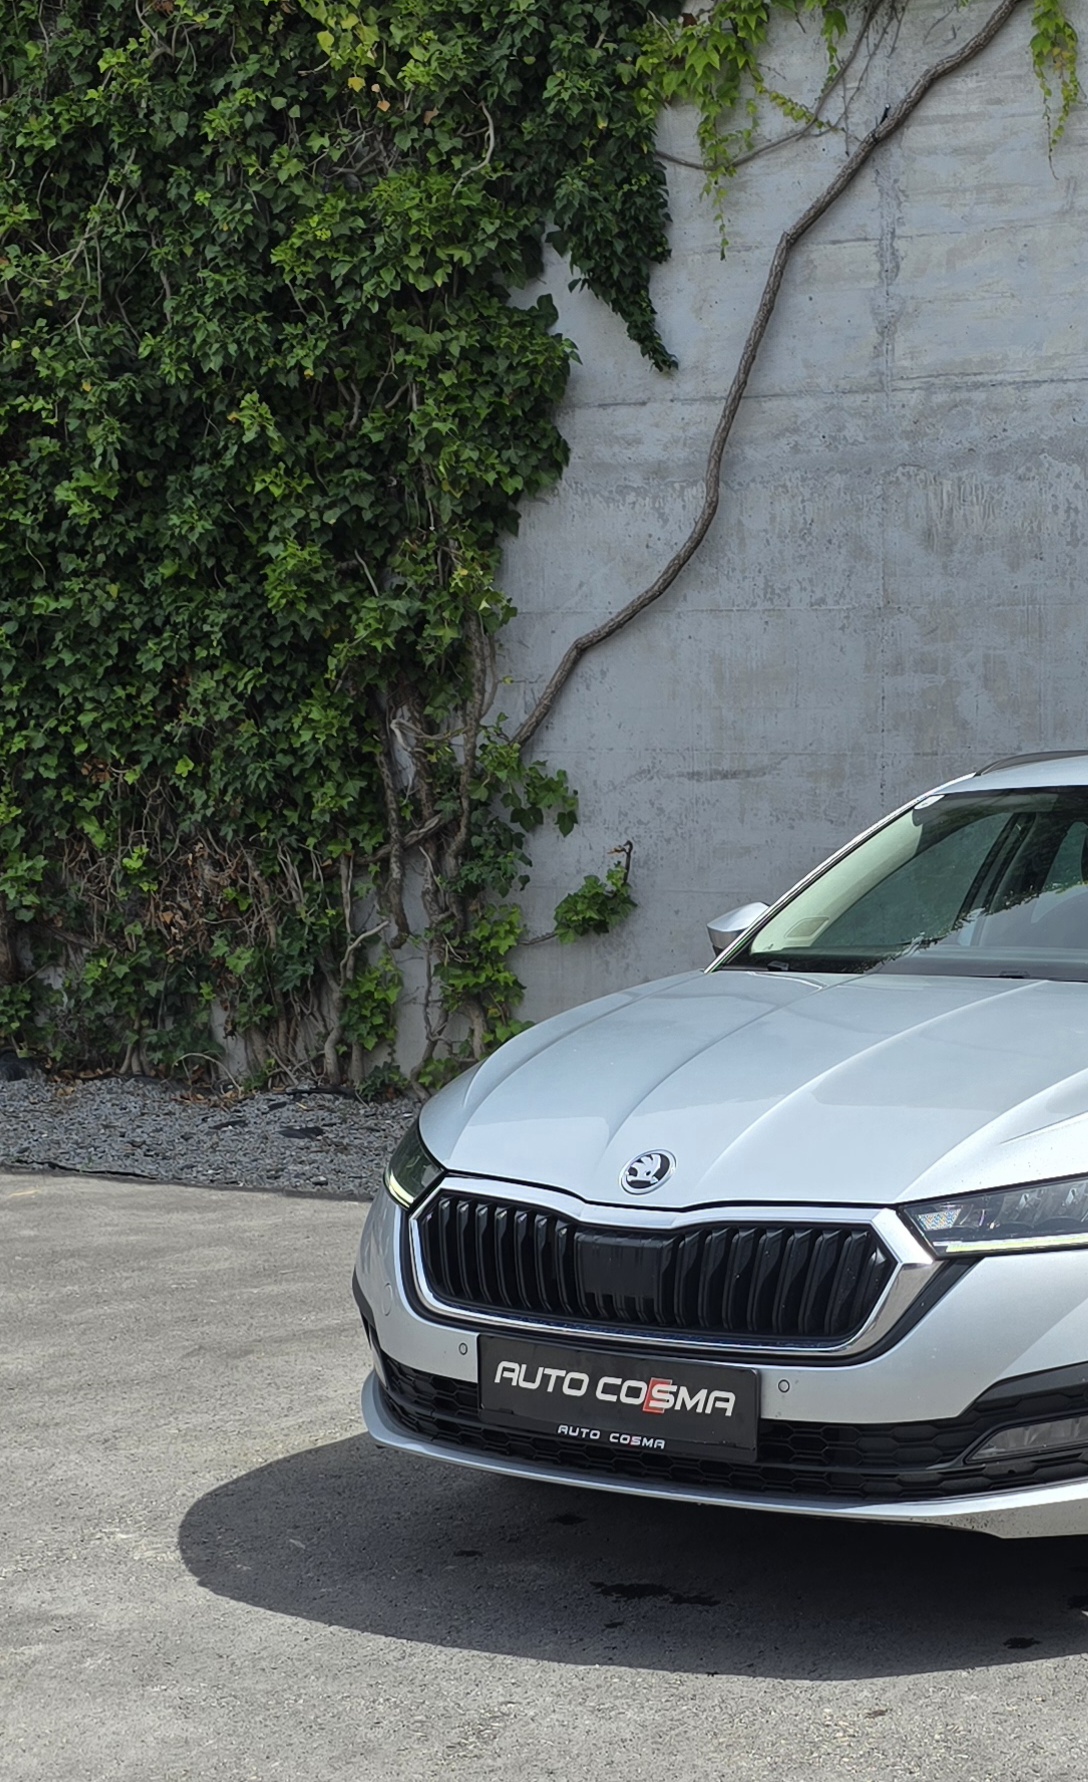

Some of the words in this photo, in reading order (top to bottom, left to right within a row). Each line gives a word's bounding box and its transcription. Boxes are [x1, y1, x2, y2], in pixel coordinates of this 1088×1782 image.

[494, 1360, 590, 1397] AUTO
[595, 1376, 736, 1417] COSMA
[557, 1424, 601, 1440] AUTO
[609, 1432, 666, 1450] COSMA
